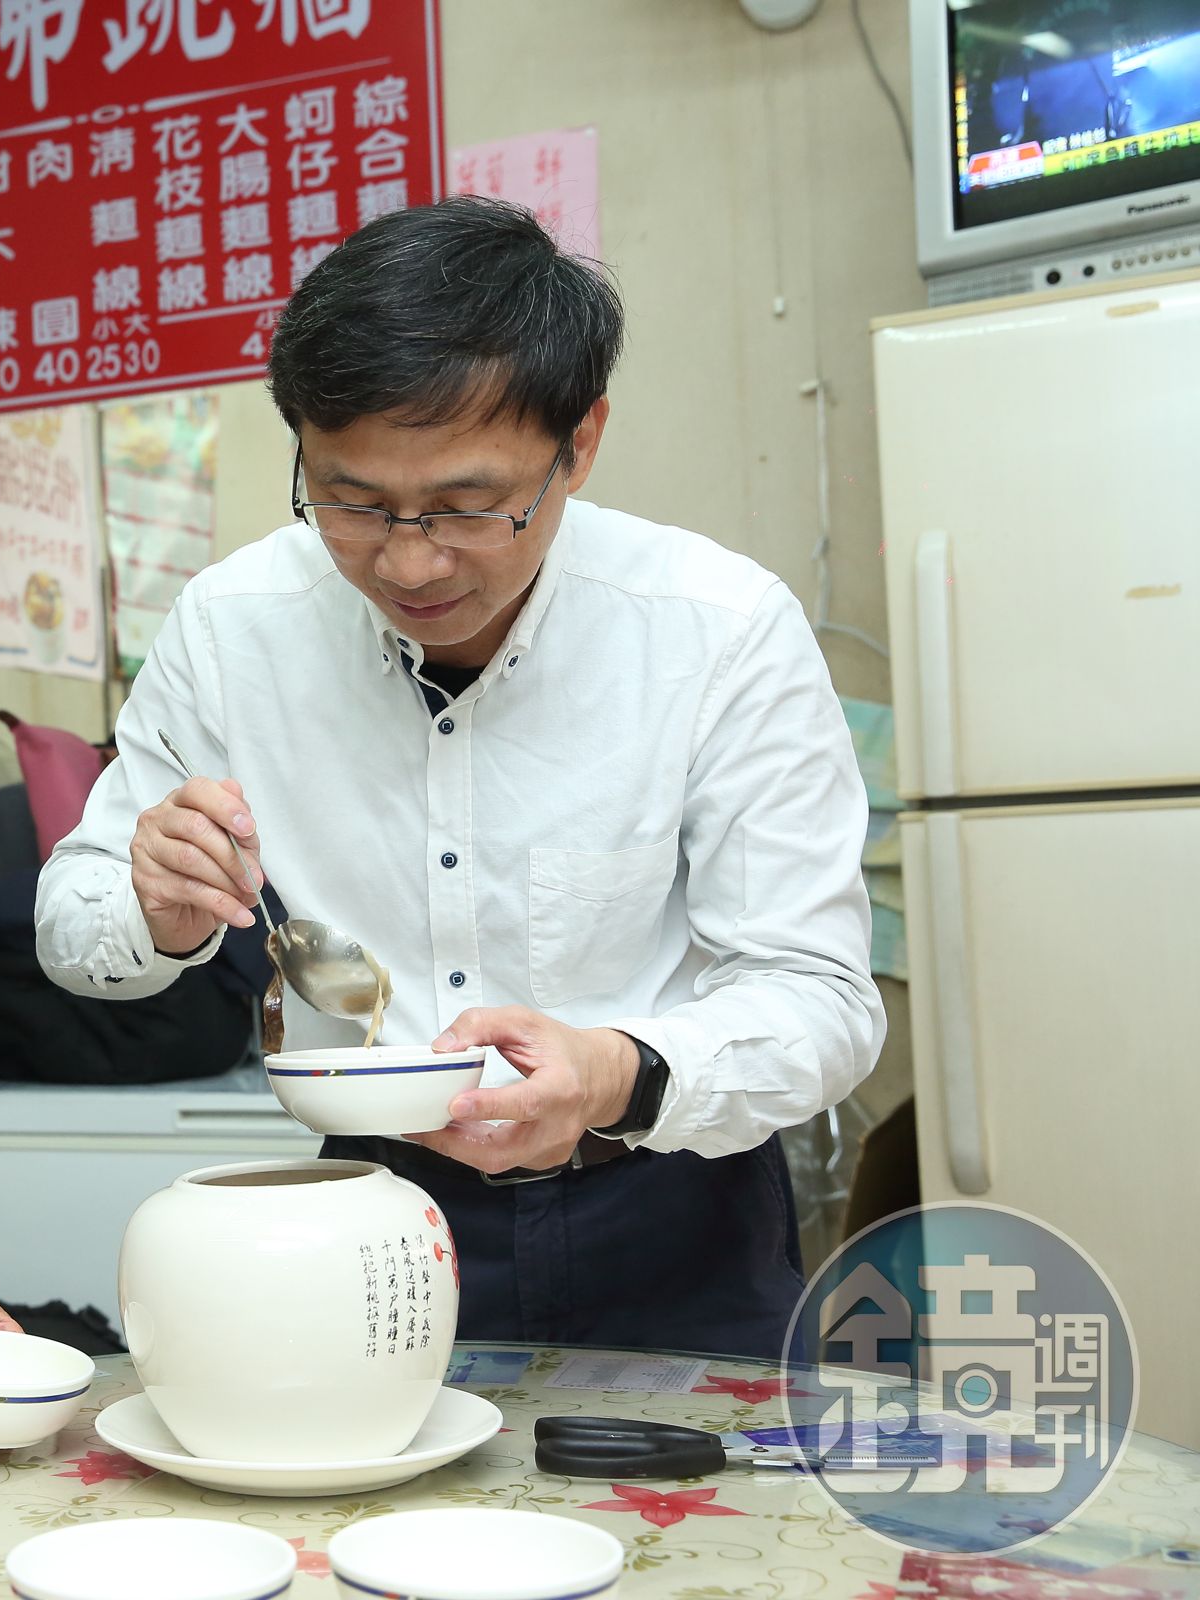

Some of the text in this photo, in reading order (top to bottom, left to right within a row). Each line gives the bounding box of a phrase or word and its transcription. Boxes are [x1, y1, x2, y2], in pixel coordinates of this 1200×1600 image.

[27, 140, 80, 346] 肉圓
[90, 129, 141, 311] 清麵線
[152, 115, 208, 311] 花枝麵線
[218, 104, 277, 302] 大腸麵線
[34, 348, 80, 385] 40
[86, 339, 160, 381] 25 30
[93, 313, 149, 340] 小 大
